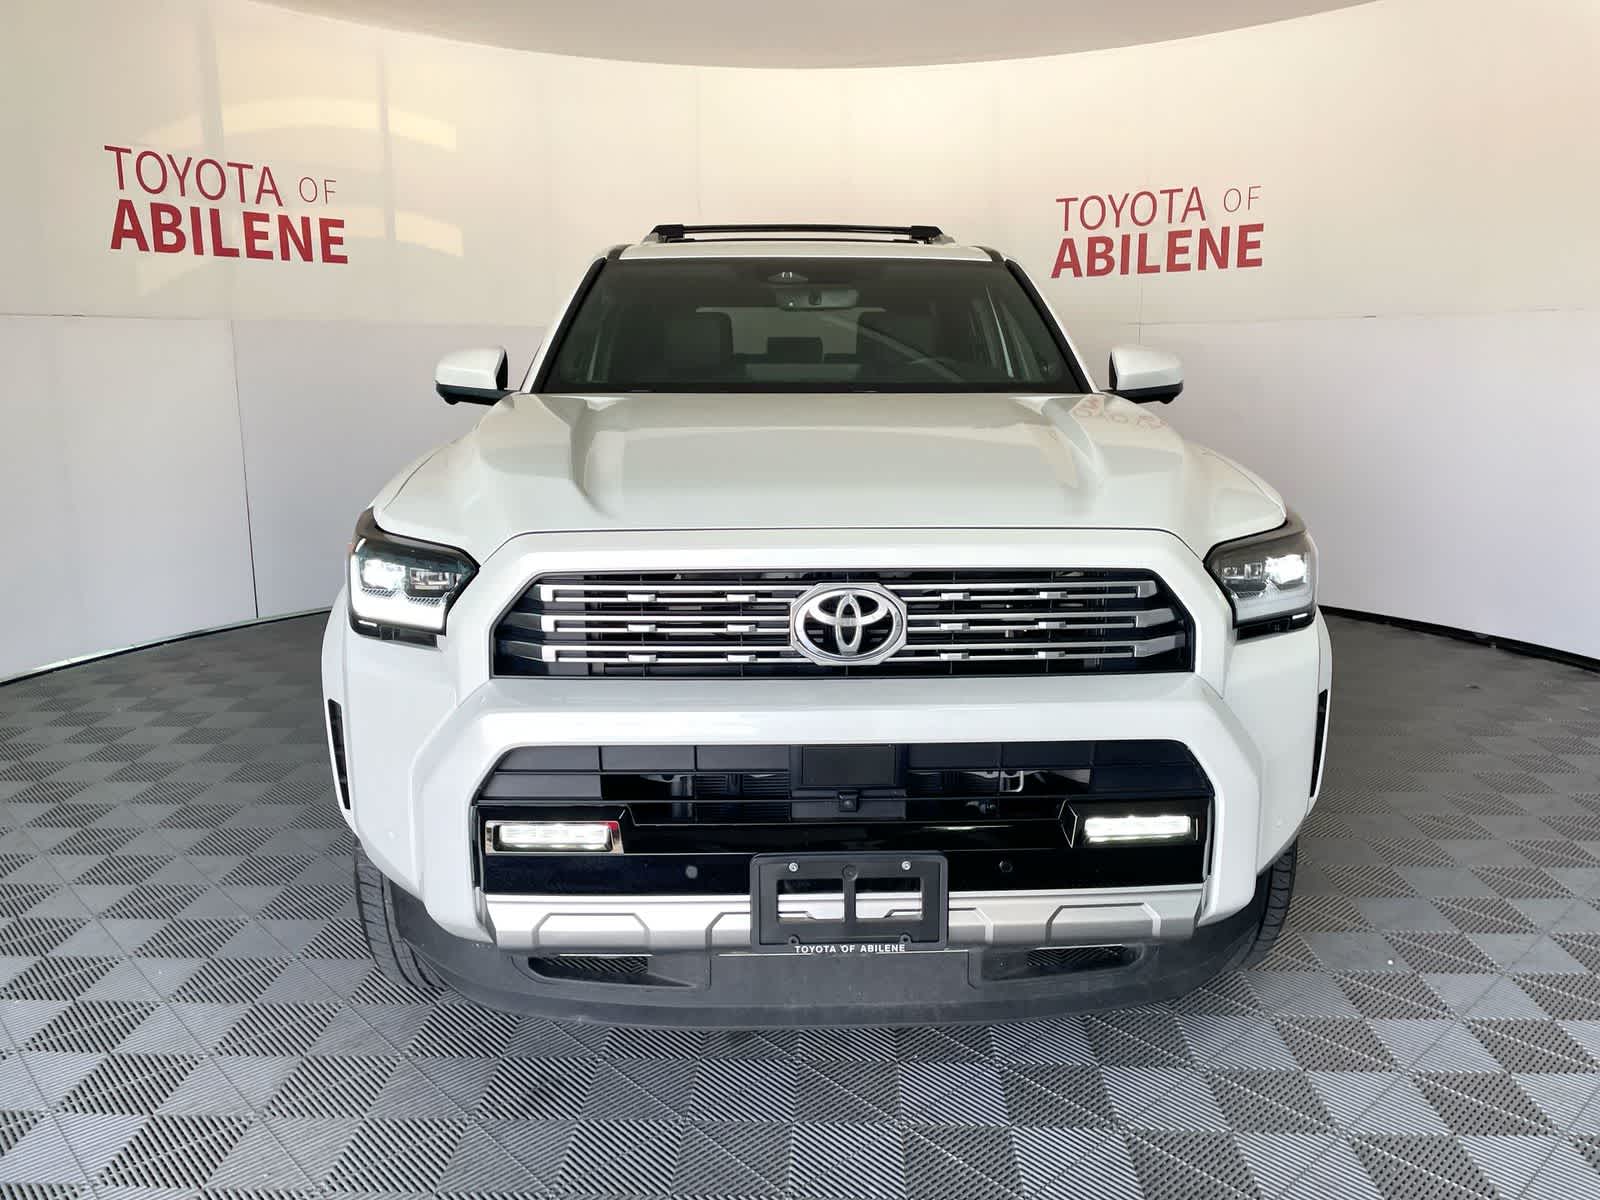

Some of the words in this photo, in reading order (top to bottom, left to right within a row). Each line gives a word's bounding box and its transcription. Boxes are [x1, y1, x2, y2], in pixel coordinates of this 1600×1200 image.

[104, 144, 284, 207] TOYOTA
[298, 176, 337, 204] OF
[110, 198, 348, 264] ABILENE
[1055, 185, 1206, 232] TOYOTA
[1222, 185, 1262, 213] OF
[1050, 223, 1265, 279] ABILENE
[794, 944, 836, 954] TOYOTA
[841, 944, 855, 953] OF
[860, 943, 906, 953] ABILENE
